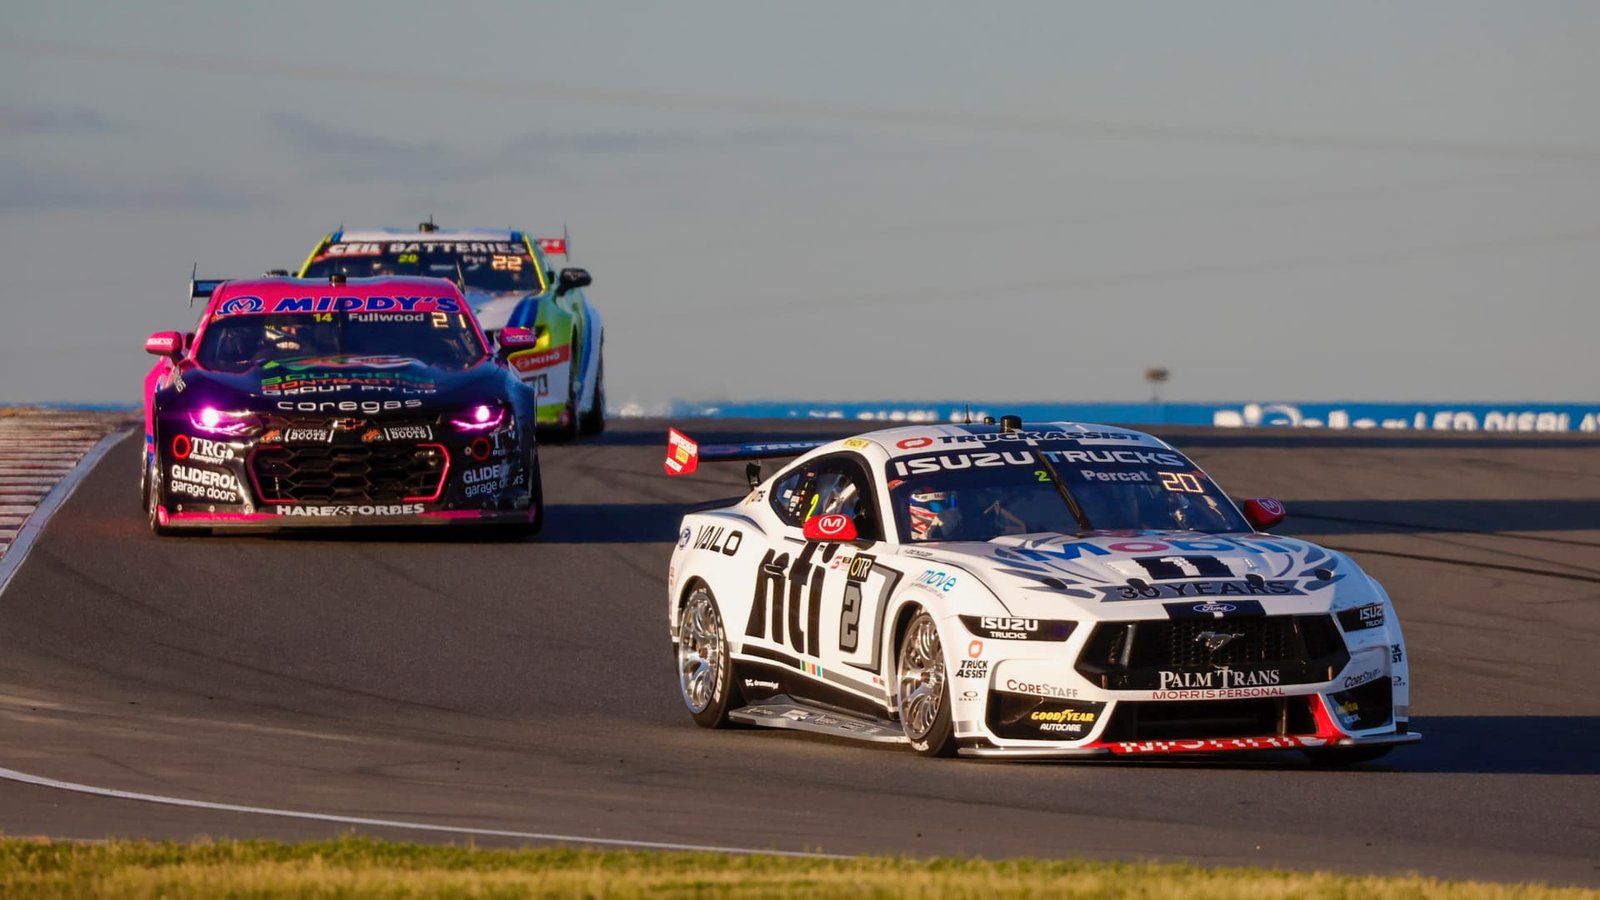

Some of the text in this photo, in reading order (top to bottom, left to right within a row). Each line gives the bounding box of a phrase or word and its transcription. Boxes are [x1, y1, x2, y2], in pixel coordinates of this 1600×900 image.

[389, 241, 526, 254] BATTERIES
[492, 254, 523, 271] 22
[273, 295, 461, 313] MIDDY'S
[312, 313, 333, 323] 14
[349, 312, 425, 323] Fullwood
[431, 311, 467, 328] 21
[262, 384, 352, 396] GROUP
[277, 399, 423, 414] coregas
[290, 431, 327, 441] BOOTS
[391, 429, 427, 440] BOOTS
[937, 430, 1143, 444] TRUCK ASSIST
[190, 437, 227, 459] TRG
[895, 449, 1186, 477] ISUZU TRUCKS
[171, 464, 239, 491] GLIDEROL
[1034, 470, 1050, 482] 2
[1081, 468, 1152, 484] Percat
[1157, 470, 1205, 494] 20
[171, 480, 237, 502] garage doors
[464, 480, 498, 498] garage
[693, 524, 744, 558] VAILO
[850, 556, 873, 579] OTR
[917, 568, 958, 593] move
[1117, 581, 1292, 600] 30 YEARS
[839, 579, 862, 653] 2
[1360, 605, 1384, 621] ISUZ
[980, 616, 1039, 632] ISUZU
[990, 631, 1028, 640] TRUCKS
[960, 660, 989, 670] TRUCK
[955, 668, 988, 679] ASSIST
[1158, 665, 1281, 691] PALM TRANS
[1152, 687, 1286, 700] MORRIS PERSONAL
[1030, 708, 1096, 723] GOODYEAR
[1039, 722, 1082, 733] AUTOCARE
